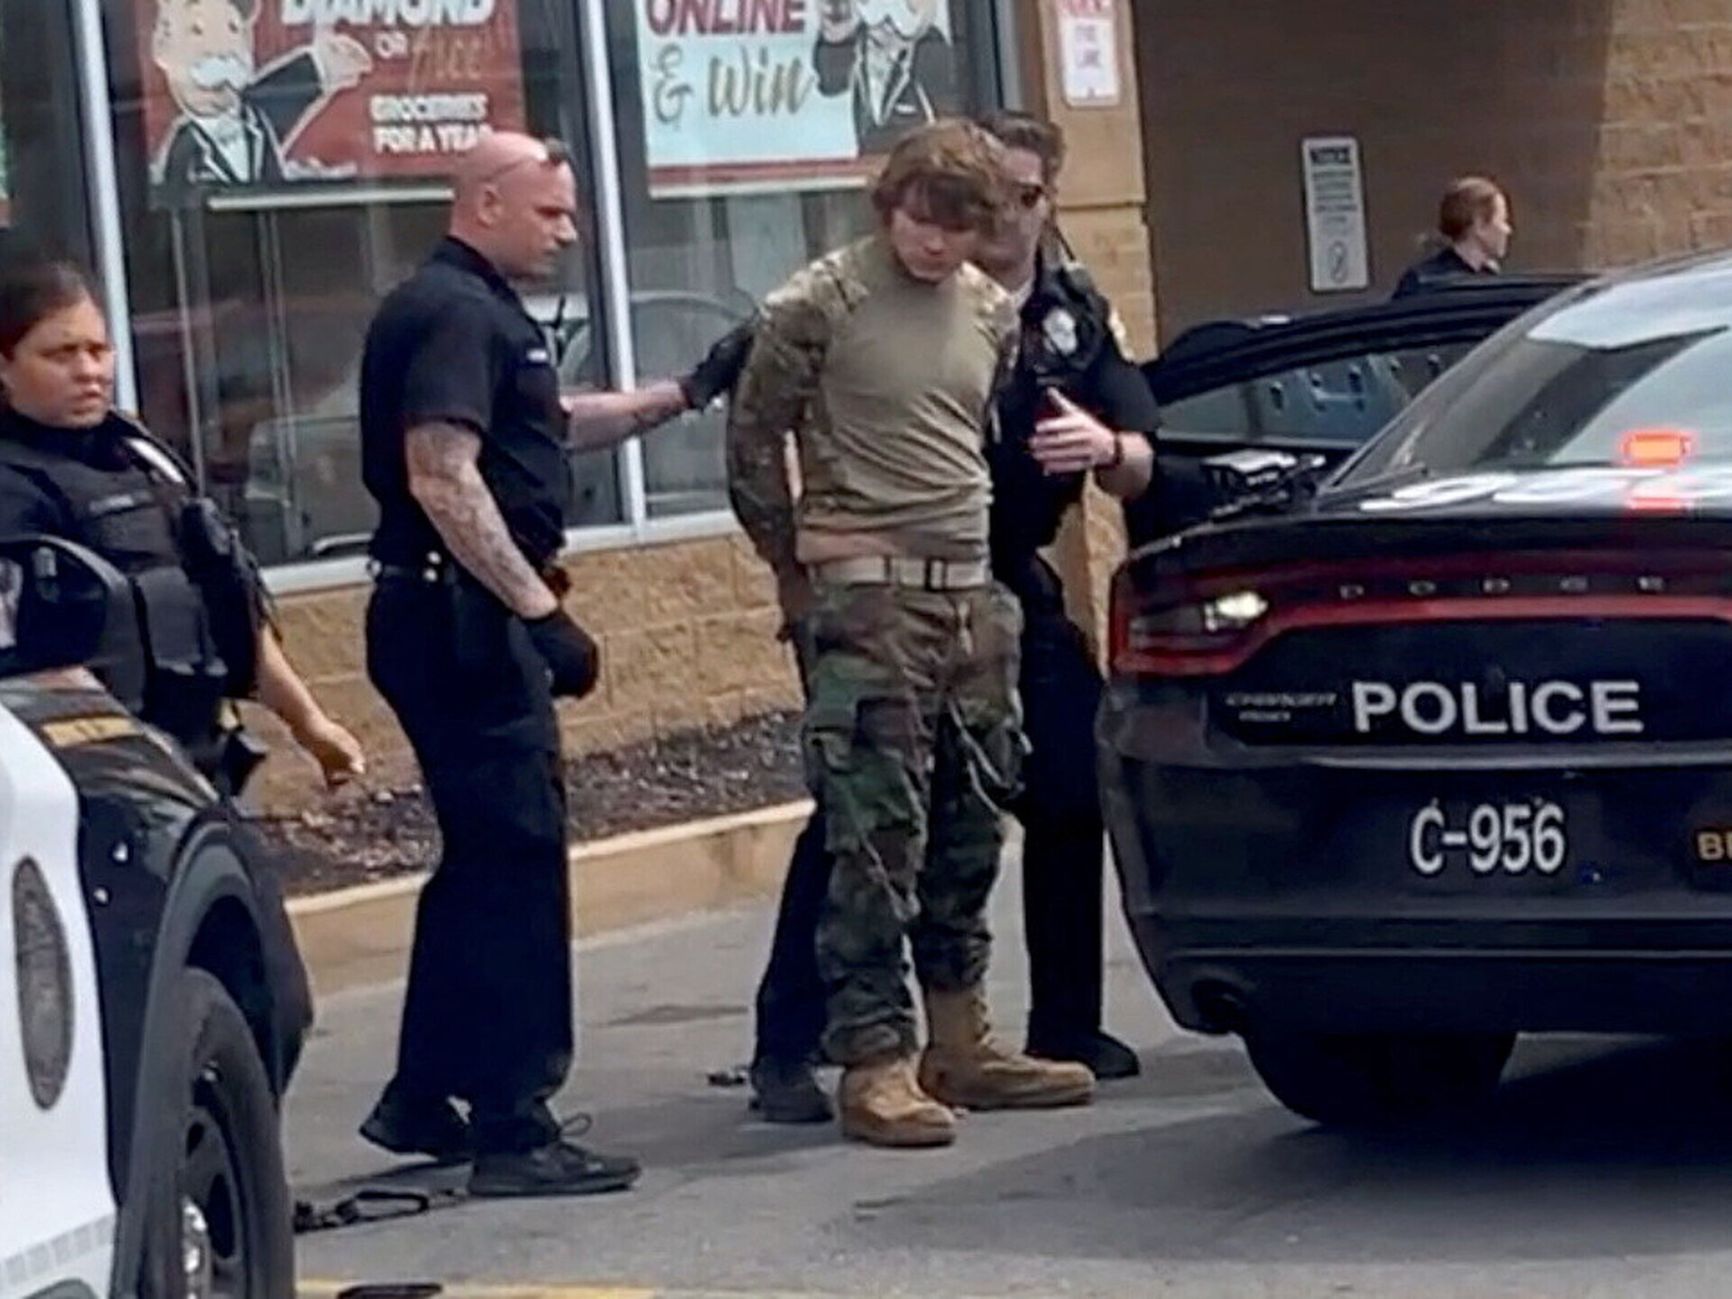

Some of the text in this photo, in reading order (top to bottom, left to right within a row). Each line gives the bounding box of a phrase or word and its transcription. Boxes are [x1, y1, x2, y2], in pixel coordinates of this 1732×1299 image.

[647, 0, 806, 35] ONLINE
[653, 44, 811, 122] & Win
[1352, 681, 1643, 734] POLICE
[1411, 803, 1566, 874] C-956
